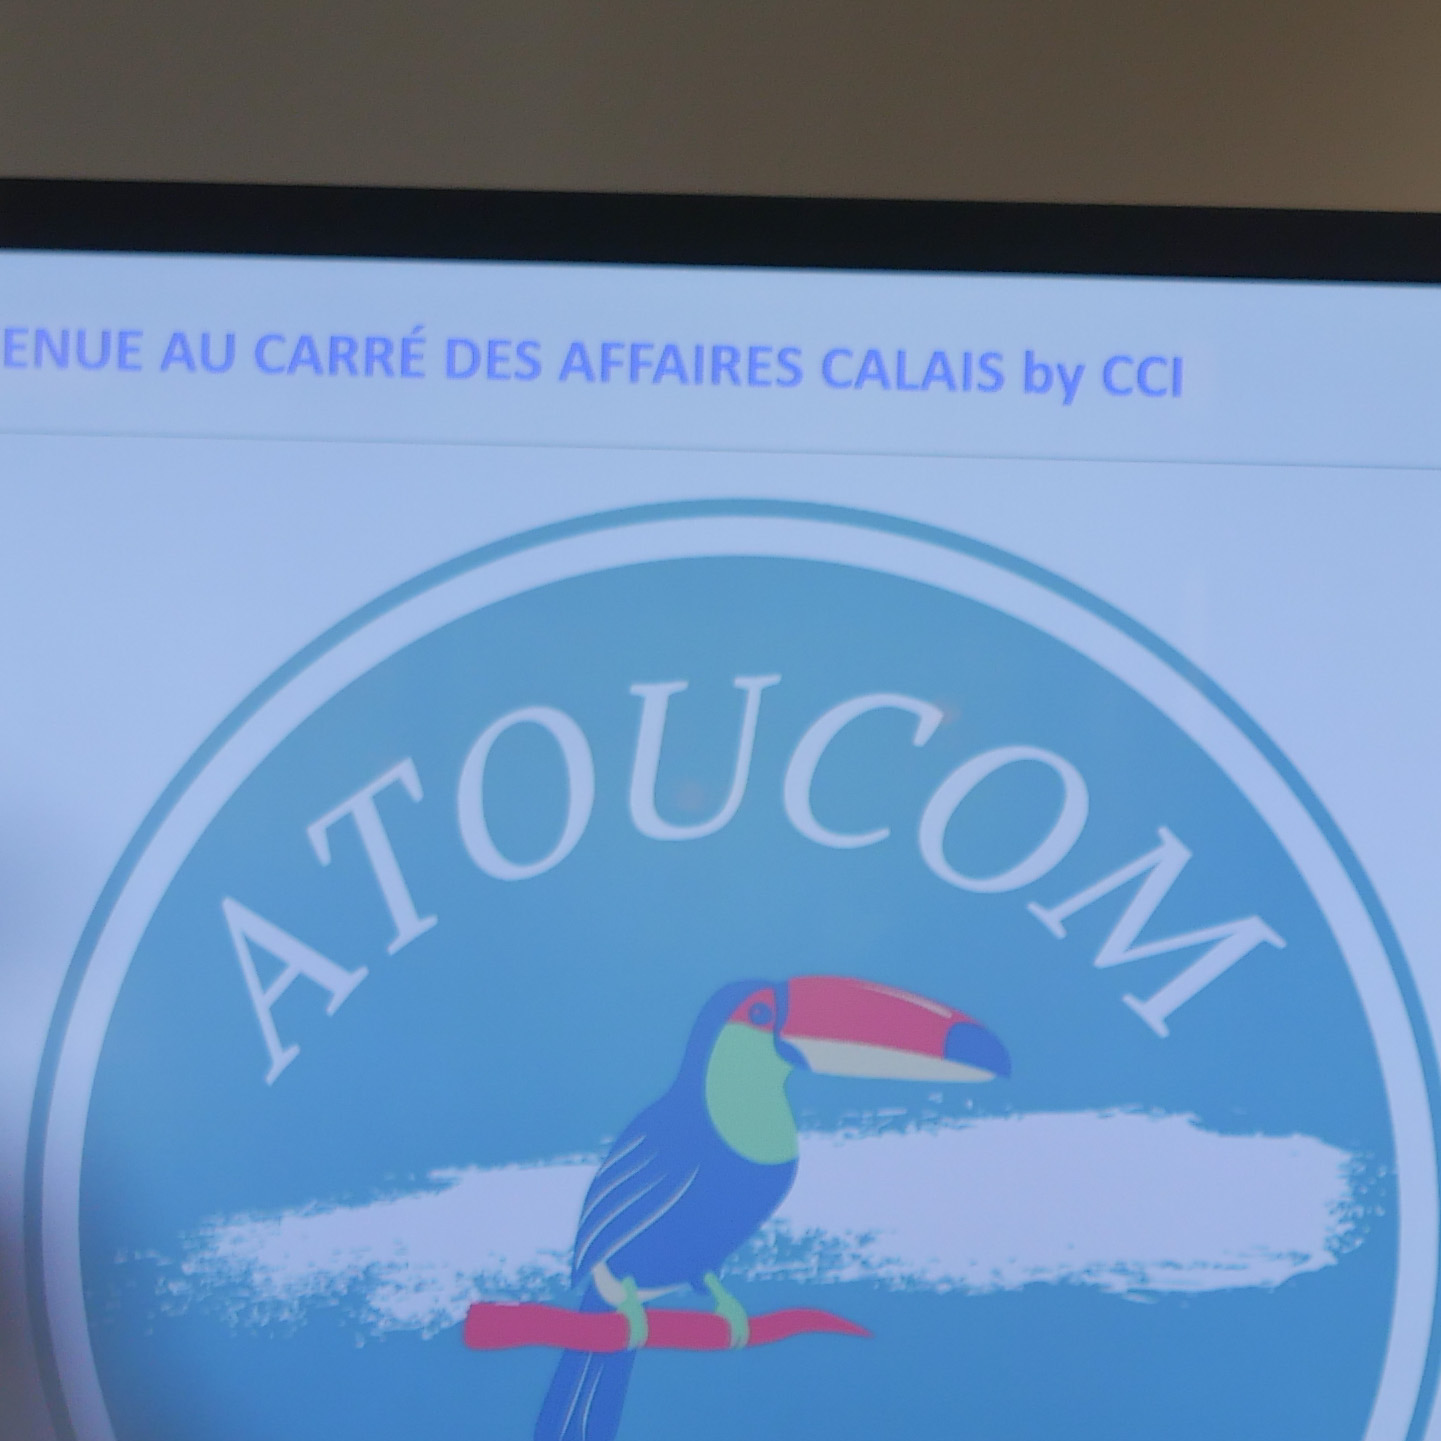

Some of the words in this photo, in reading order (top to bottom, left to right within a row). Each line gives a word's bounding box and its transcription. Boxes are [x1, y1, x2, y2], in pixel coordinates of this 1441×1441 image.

[3, 326, 144, 373] ENUE
[160, 331, 237, 374] AU
[253, 324, 427, 379] CARRÉ
[446, 337, 543, 382] DES
[558, 340, 804, 388] AFFAIRES
[821, 346, 1005, 393] CALAIS
[1023, 349, 1086, 406] by
[1102, 354, 1184, 398] CCI
[220, 673, 1287, 1085] ATOUCOM
